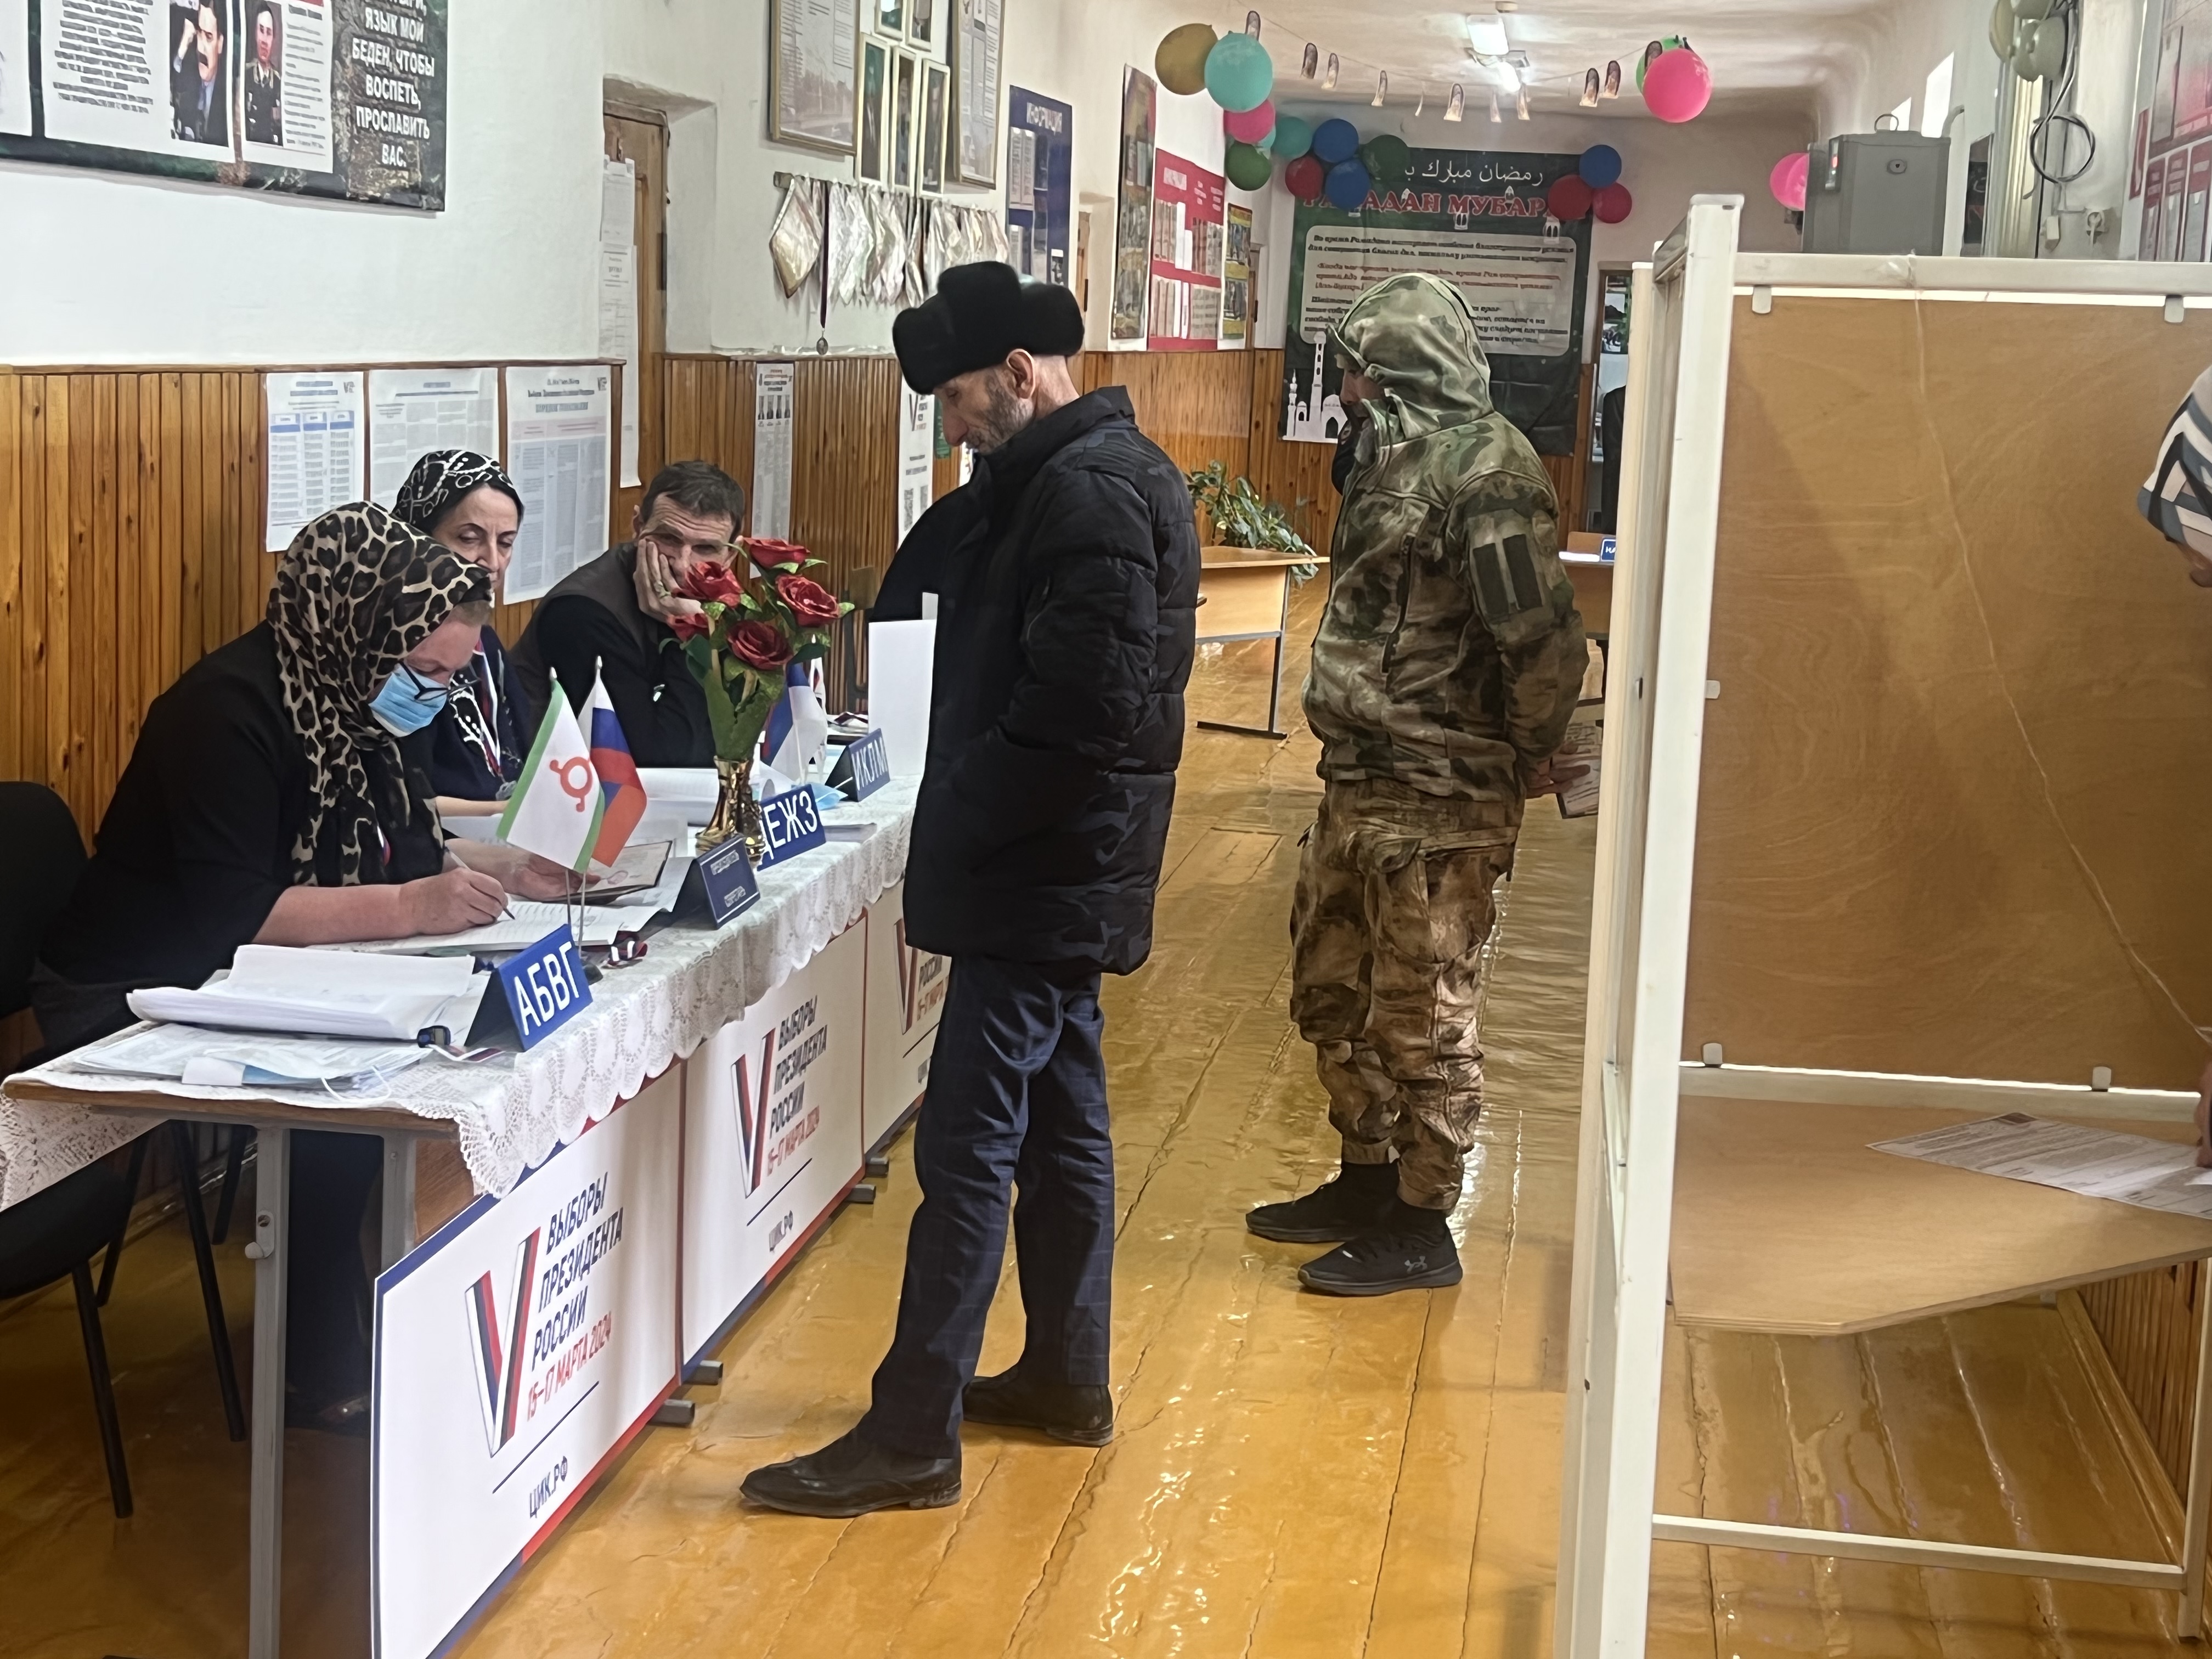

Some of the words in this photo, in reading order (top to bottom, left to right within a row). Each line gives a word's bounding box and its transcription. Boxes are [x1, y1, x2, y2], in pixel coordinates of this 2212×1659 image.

[365, 7, 398, 36] ЯЗЫК
[400, 16, 424, 43] МОЙ
[352, 37, 393, 72] БЕДЕН,
[396, 49, 435, 77] ЧТОБЫ
[366, 74, 421, 110] ВОСПЕТЬ,
[356, 105, 430, 139] ПРОСЛАВИТЬ
[381, 143, 407, 167] ВАС.
[1479, 162, 1543, 186] رمضان
[1304, 189, 1442, 214] АДАН
[1448, 194, 1585, 219] МУБАР
[851, 736, 888, 791] ИКЛМ
[514, 941, 579, 1036] АБВГ
[545, 1171, 608, 1256] ВЫБОРЫ
[538, 1207, 623, 1313] ПРЕЗИДЕНТА
[532, 1285, 588, 1372] РОССИИ
[555, 1333, 588, 1388] МАРТА
